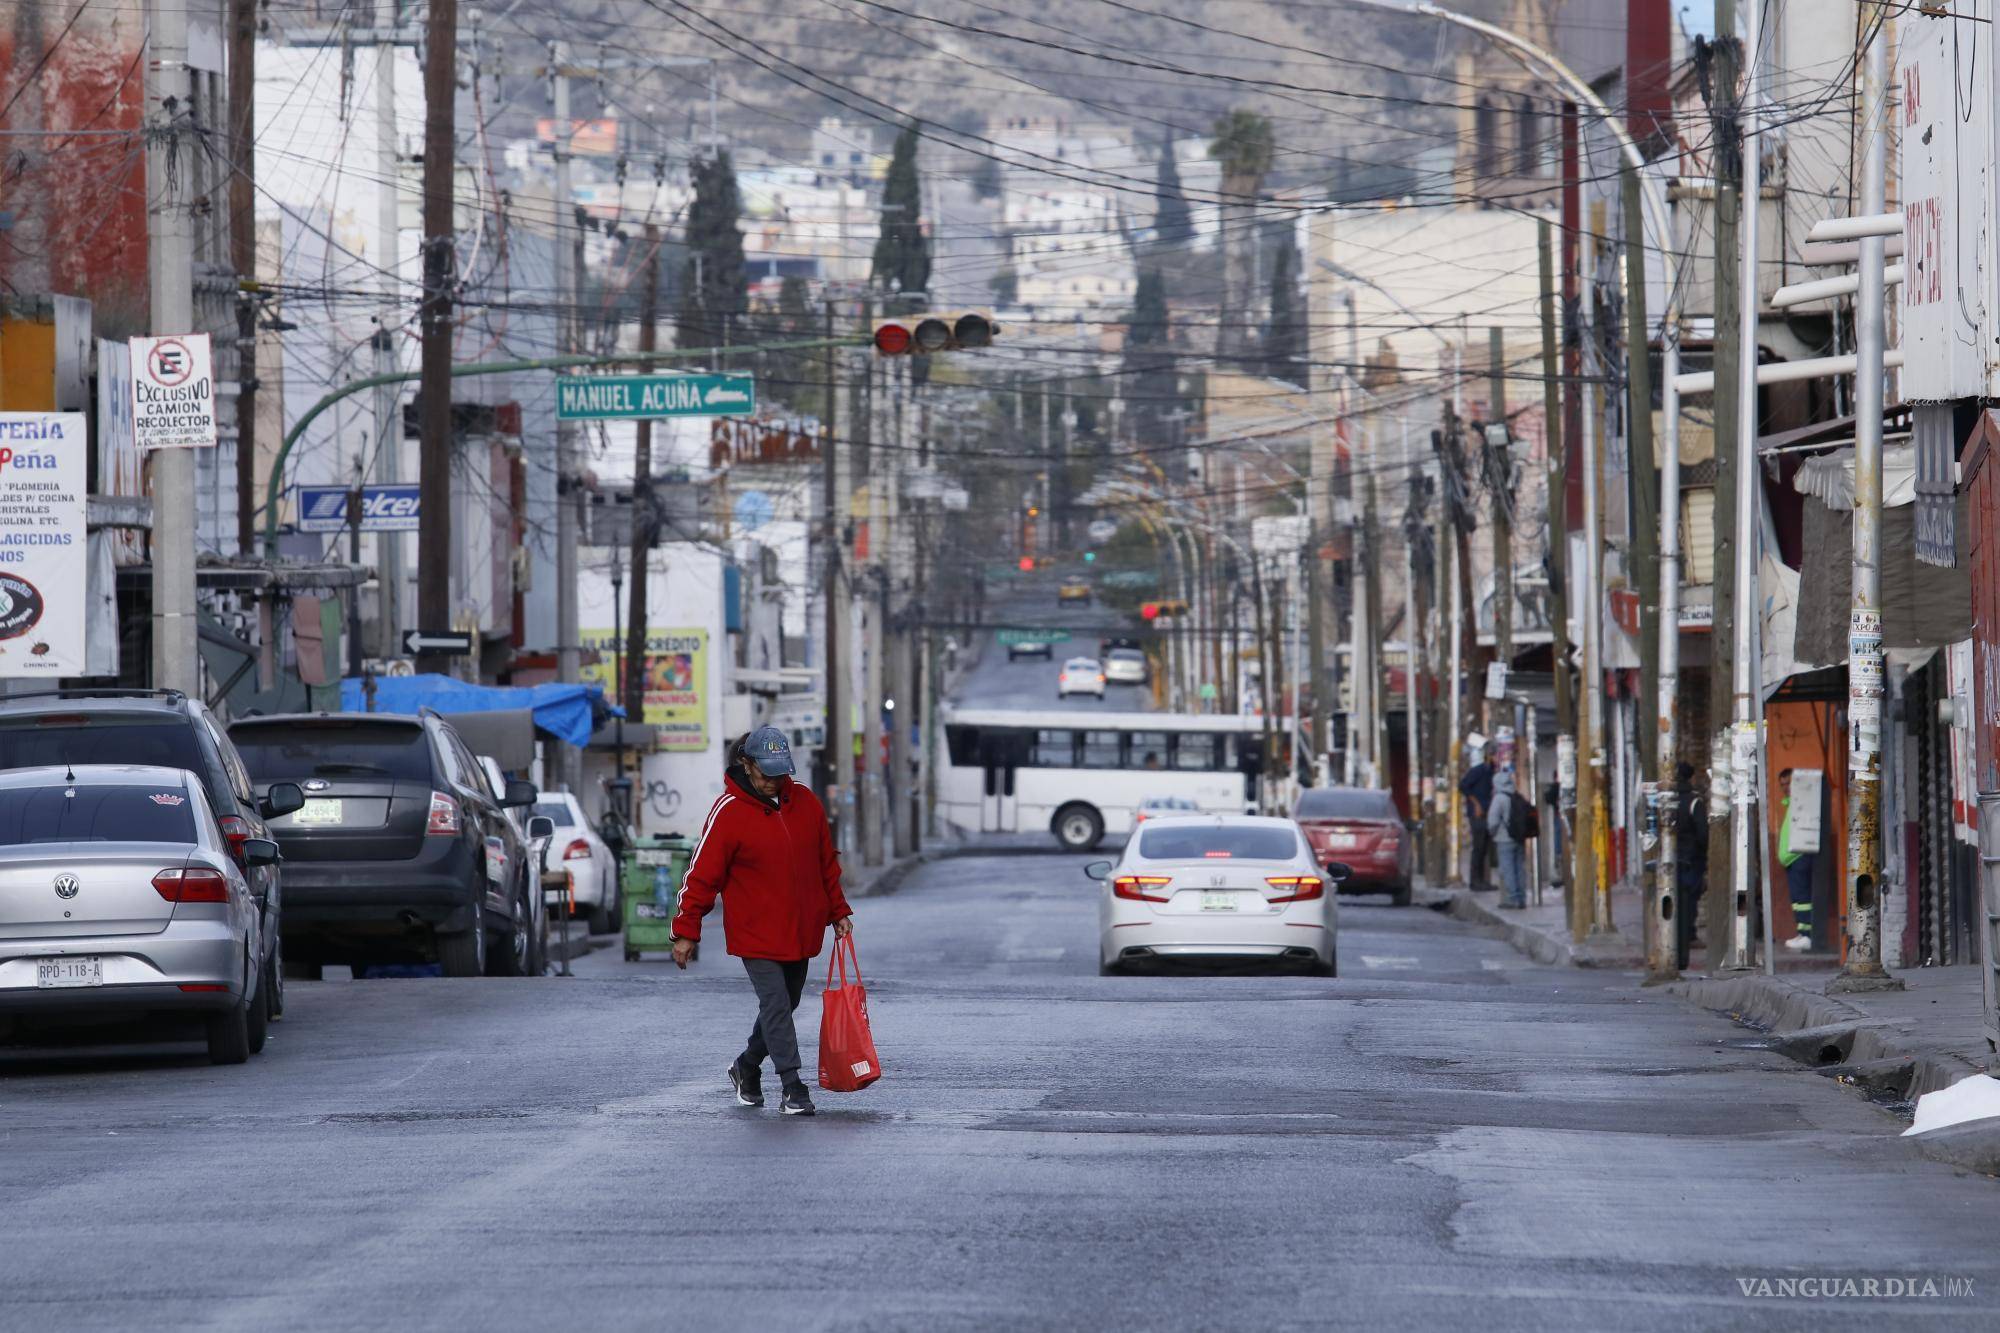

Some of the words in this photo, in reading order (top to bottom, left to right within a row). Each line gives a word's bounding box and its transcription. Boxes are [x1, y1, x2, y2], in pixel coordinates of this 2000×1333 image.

[136, 377, 209, 402] EXCLUSIVO
[563, 384, 634, 411] MANUEL
[641, 379, 702, 410] ACUÑA
[147, 402, 201, 415] CAMION
[137, 416, 210, 428] RECOLECTOR
[0, 447, 57, 473] Peña
[39, 494, 75, 502] COCINA
[40, 963, 100, 978] RPD-118-A
